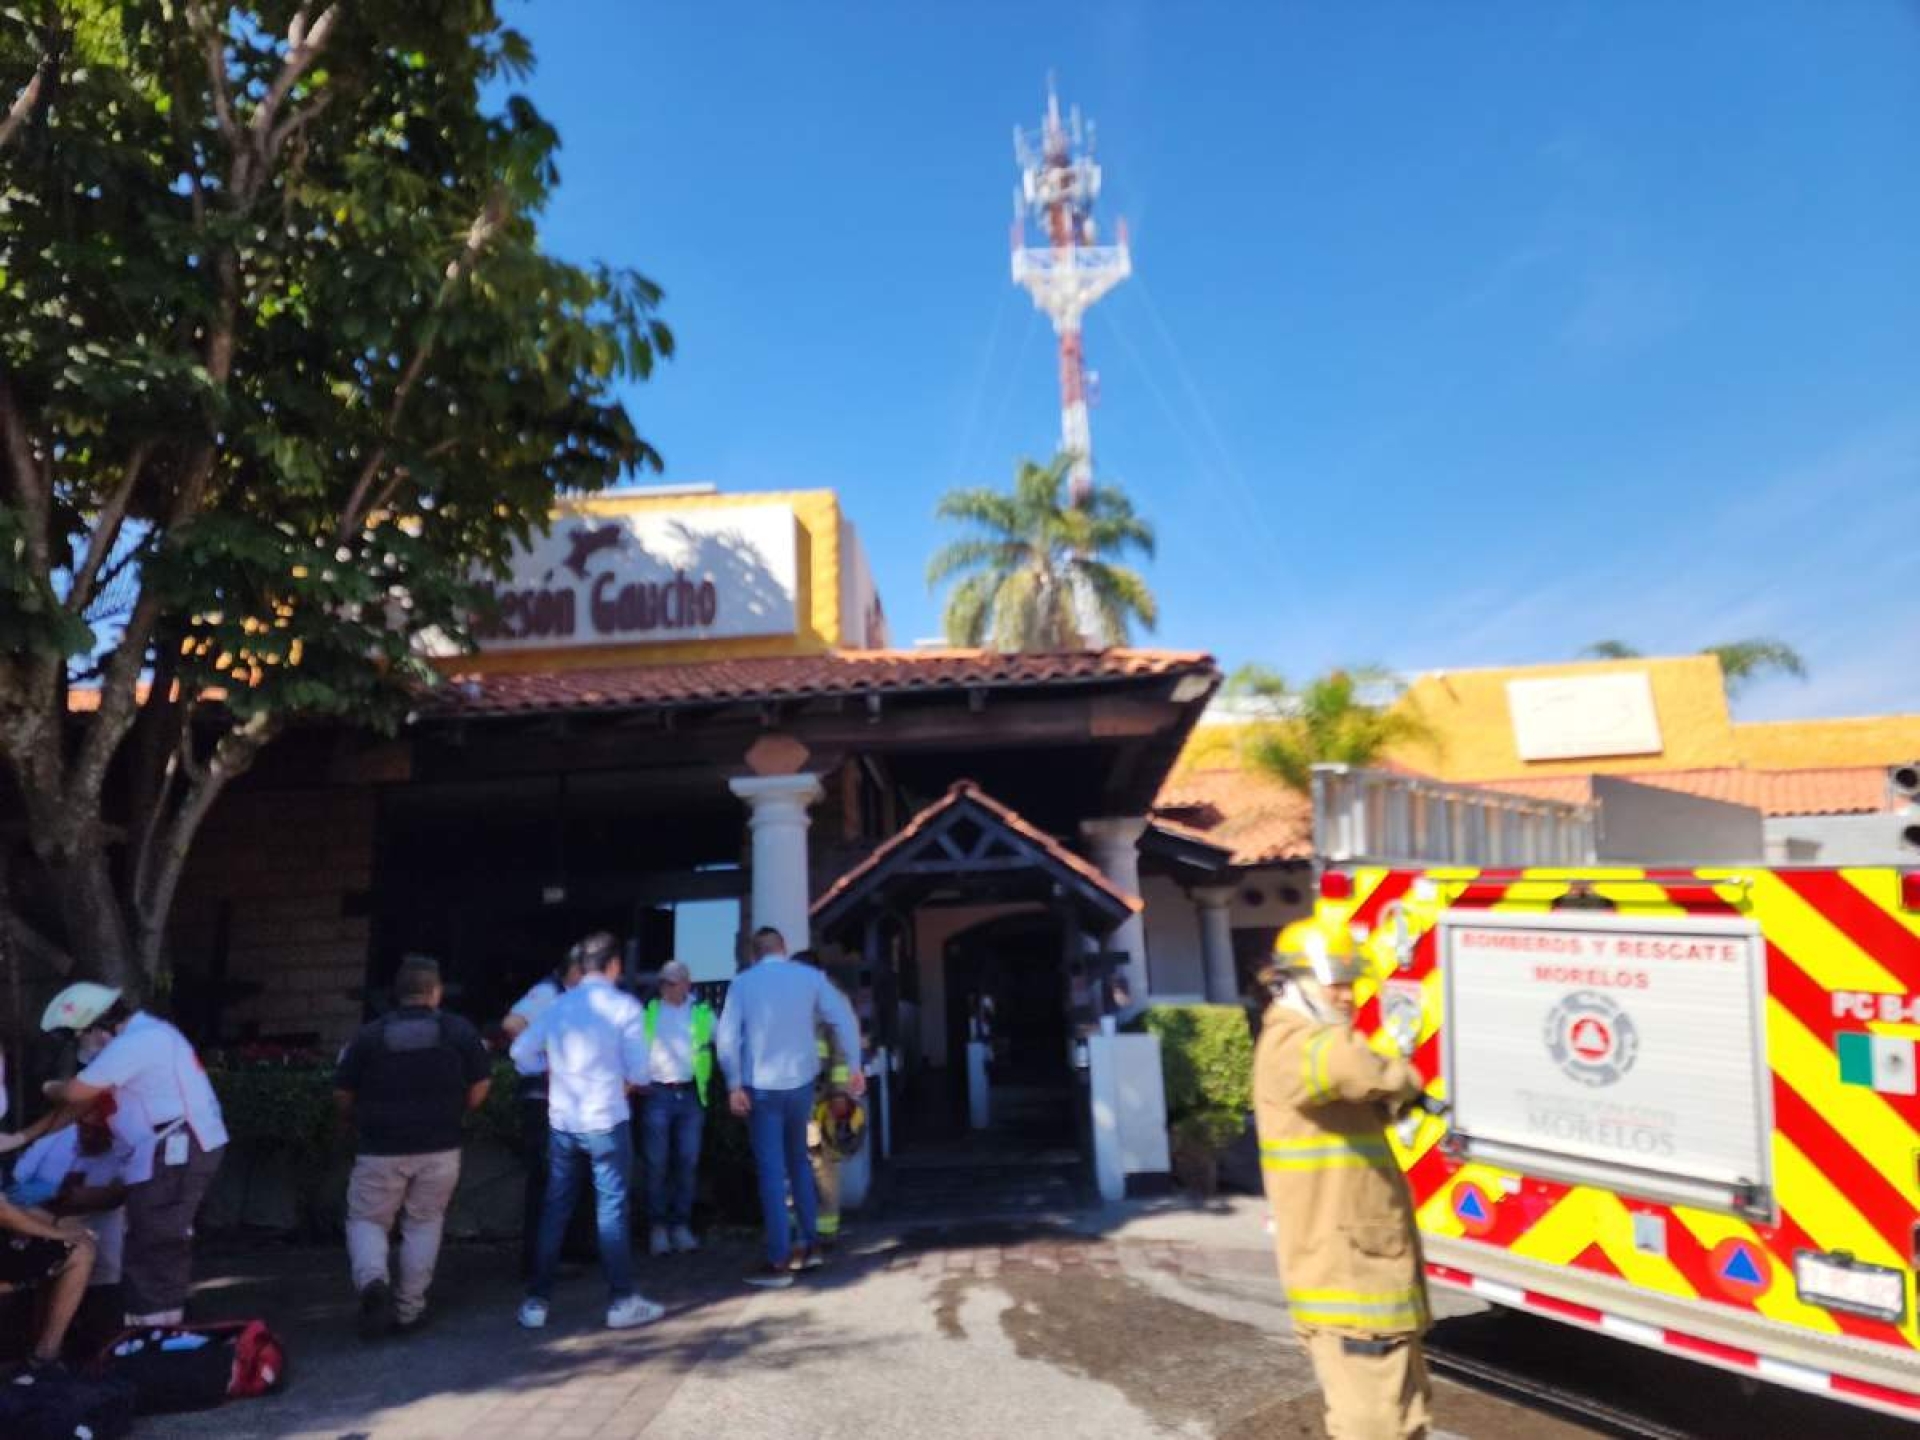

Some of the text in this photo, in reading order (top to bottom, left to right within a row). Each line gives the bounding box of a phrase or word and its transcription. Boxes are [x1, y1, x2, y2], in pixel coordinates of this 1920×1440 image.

[590, 569, 716, 633] Gaucho
[1462, 932, 1737, 962] BOMBEROS Y RESCATE
[1534, 966, 1649, 989] MORELOS
[1831, 990, 1876, 1020] PC
